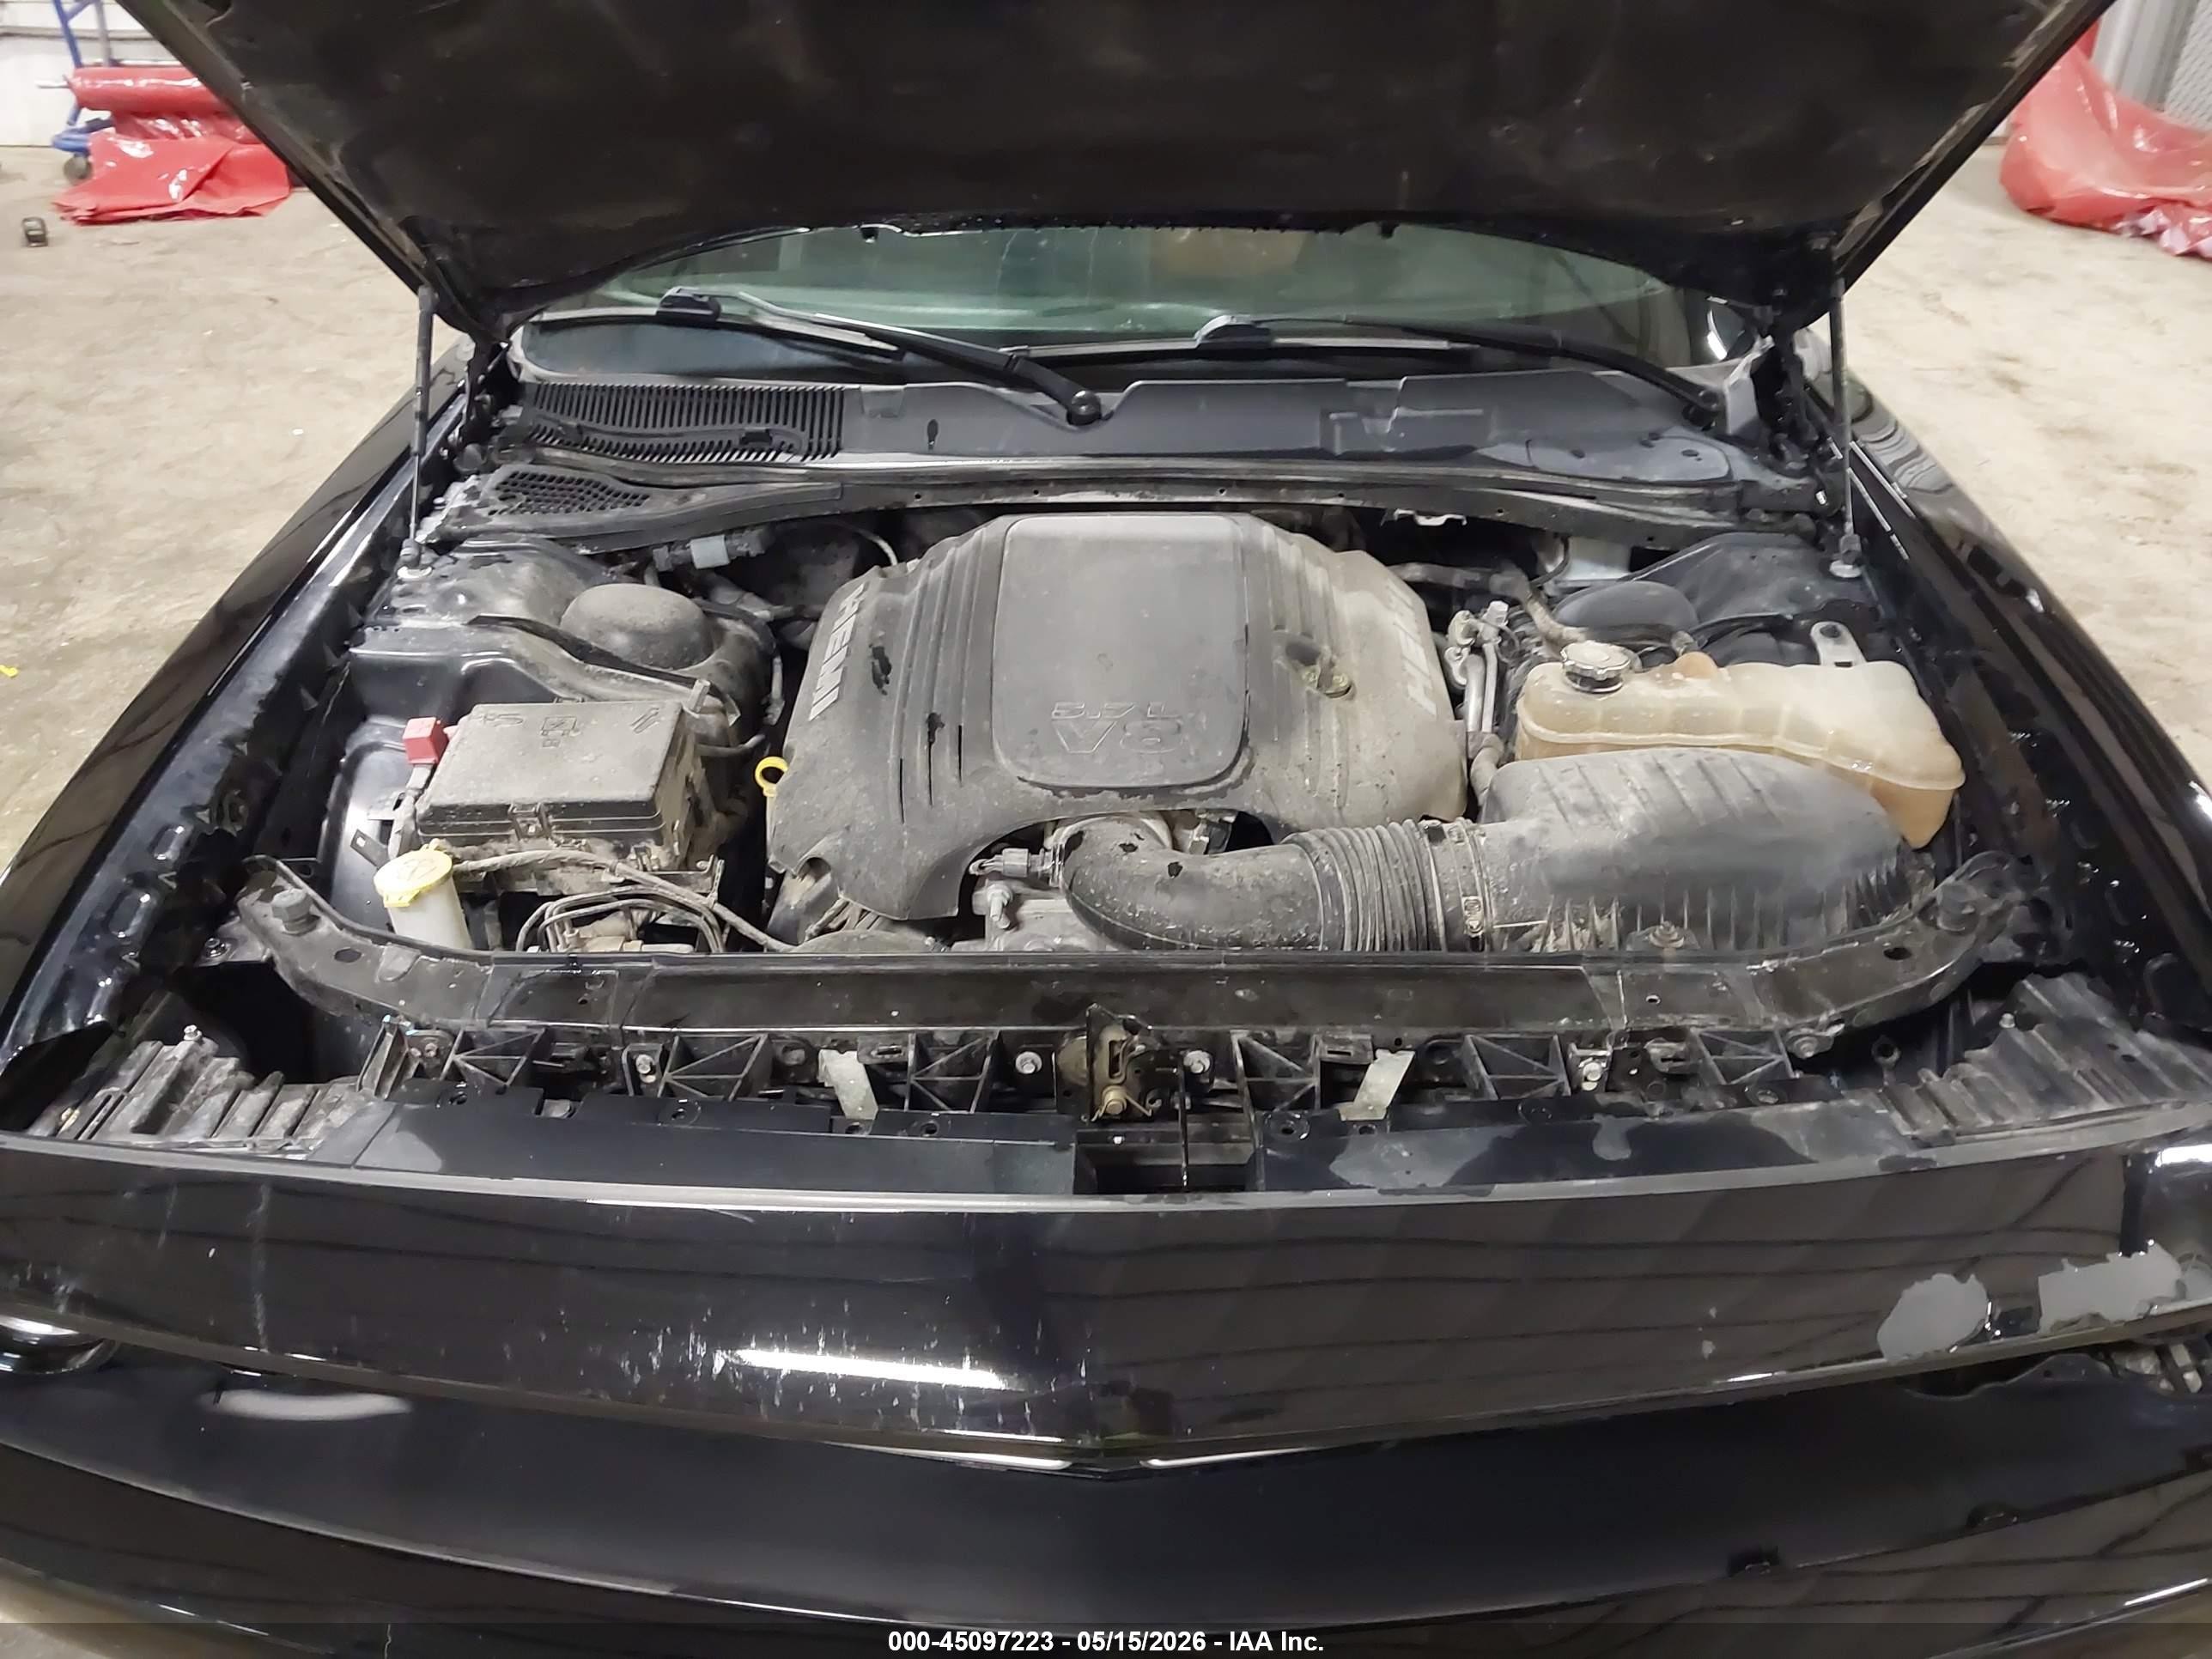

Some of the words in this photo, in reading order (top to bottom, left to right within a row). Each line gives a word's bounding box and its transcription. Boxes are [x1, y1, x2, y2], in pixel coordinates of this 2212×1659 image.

[808, 582, 867, 721] HEMI
[1051, 702, 1181, 719] 5.7L
[1052, 720, 1184, 754] V8
